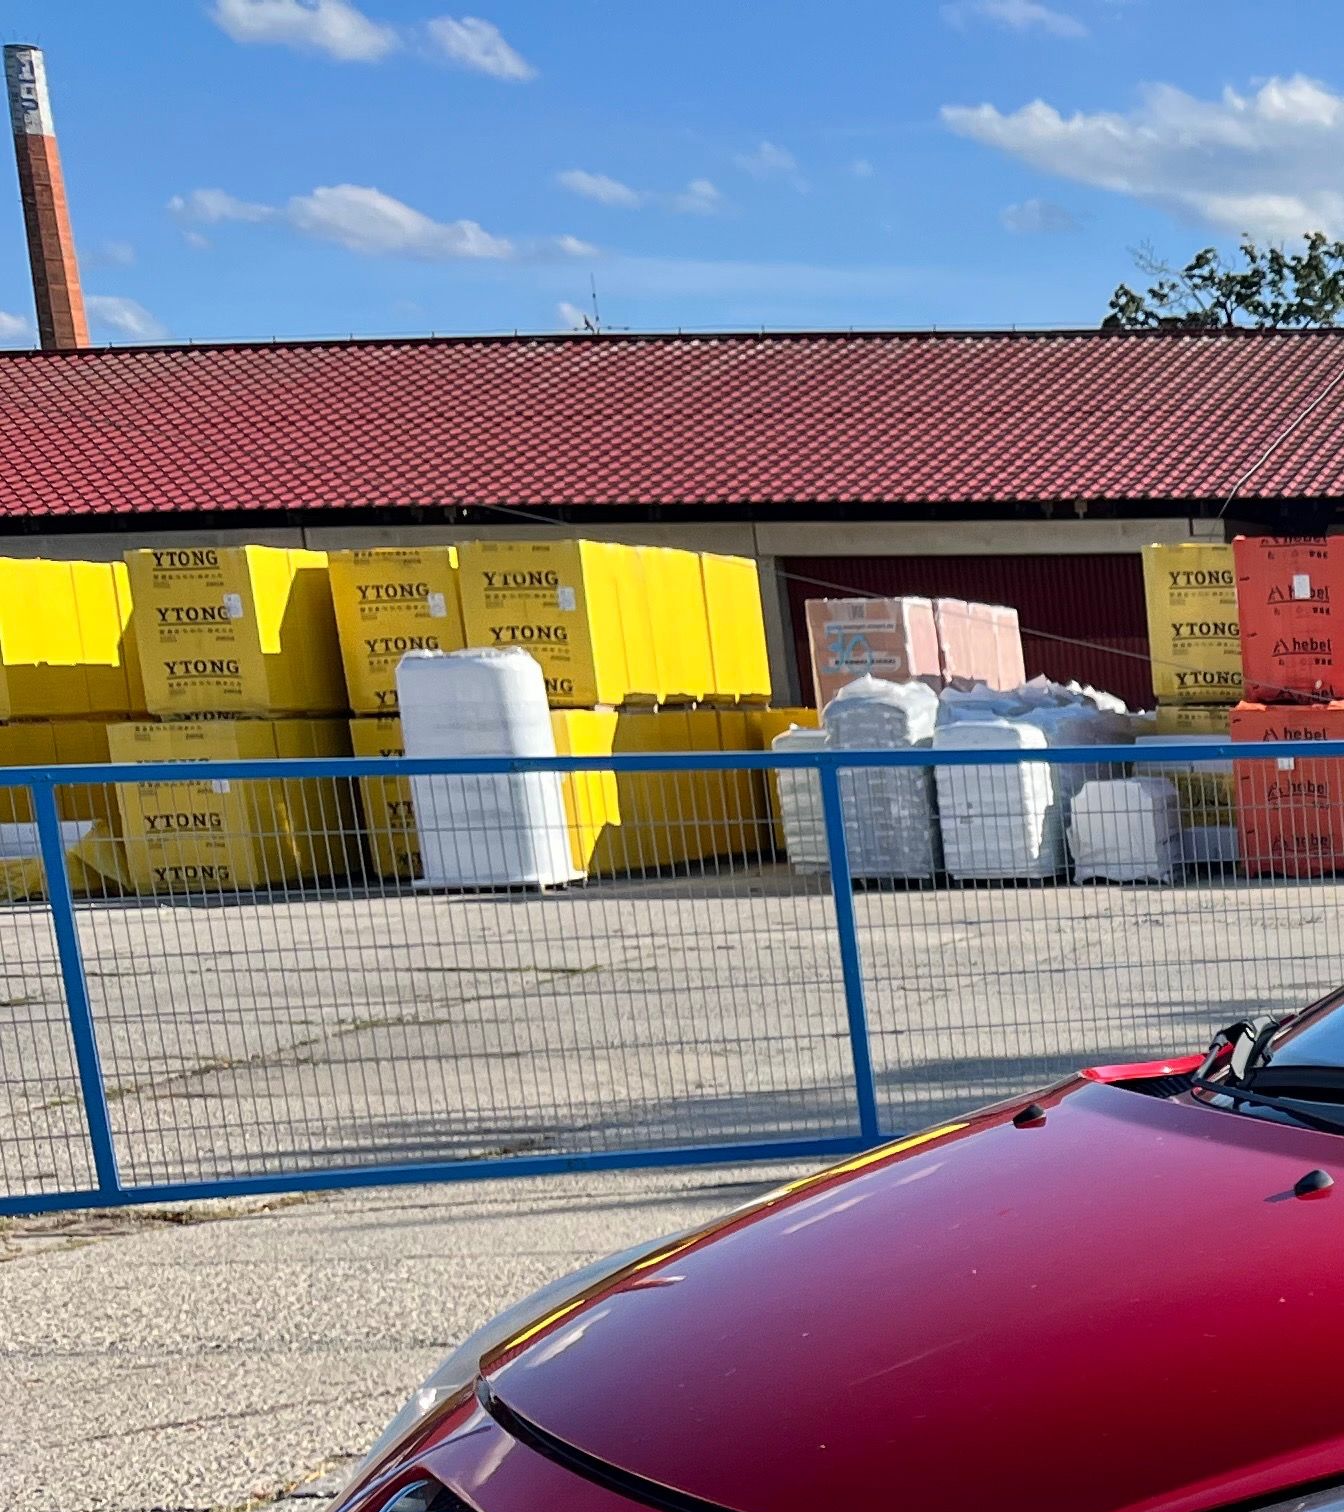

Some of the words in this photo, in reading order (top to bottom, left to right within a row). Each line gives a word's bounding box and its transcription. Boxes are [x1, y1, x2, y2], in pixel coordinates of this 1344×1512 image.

[153, 550, 218, 566] YTONG
[483, 570, 560, 587] YTONG
[1169, 570, 1234, 587] YTONG
[357, 582, 430, 600] YTONG
[156, 606, 231, 622] YTONG
[490, 625, 568, 643] YTONG
[1172, 622, 1240, 637] YTONG
[365, 635, 439, 653] YTONG
[1293, 637, 1332, 651] hebel
[164, 659, 240, 675] YTONG
[1176, 672, 1242, 687] YTONG
[1284, 727, 1327, 741] hebel
[144, 812, 222, 830] YTONG
[154, 865, 230, 881] YTONG
